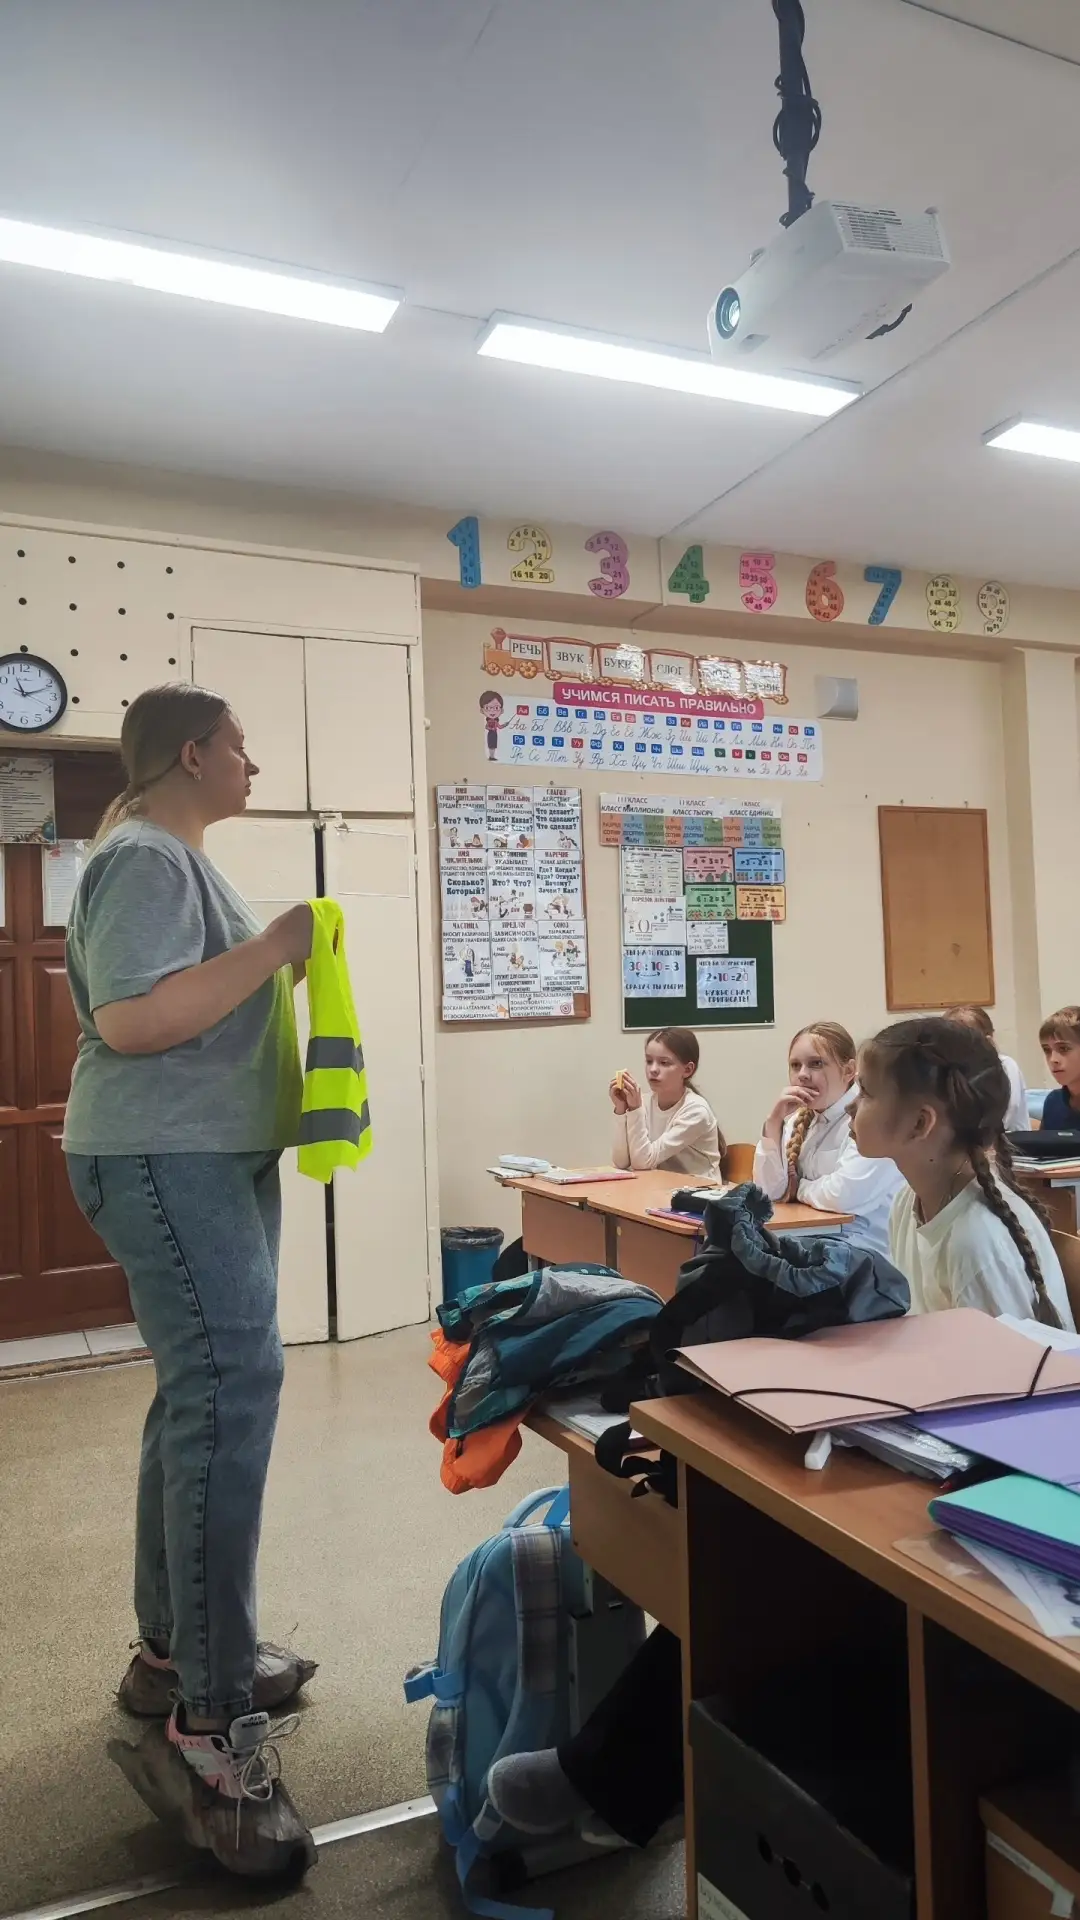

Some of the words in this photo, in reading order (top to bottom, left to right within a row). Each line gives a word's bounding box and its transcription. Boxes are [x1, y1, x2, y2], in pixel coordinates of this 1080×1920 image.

[447, 516, 481, 588] 1
[507, 524, 554, 583] 2
[585, 531, 630, 599] 3
[668, 545, 709, 603] 4
[740, 553, 777, 613] 5
[805, 560, 844, 622] 6
[864, 566, 901, 625] 7
[926, 574, 960, 633] 8
[977, 581, 1010, 636] 9
[512, 642, 541, 655] РЕЧЬ
[556, 652, 584, 663] ЗВУК
[7, 666, 15, 675] 11
[20, 664, 30, 672] 12
[38, 669, 41, 677] 1
[656, 664, 684, 676] СЛОГ
[46, 679, 53, 688] 2
[49, 692, 58, 701] 3
[562, 688, 620, 704] УЧИМСЯ
[624, 692, 676, 709] ПИСАТЬ
[680, 698, 756, 714] ПРАВИЛЬНО
[7, 711, 14, 720] 7
[45, 706, 53, 714] 4
[20, 716, 28, 725] 6
[34, 714, 42, 722] 5
[510, 718, 527, 730] Аа
[592, 723, 607, 740] Дд
[528, 749, 540, 761] Сс
[572, 751, 584, 768] Уу
[609, 754, 628, 766] Хх
[446, 888, 485, 896] Который?
[629, 962, 641, 971] 30
[651, 962, 662, 971] 10
[673, 962, 679, 971] 3
